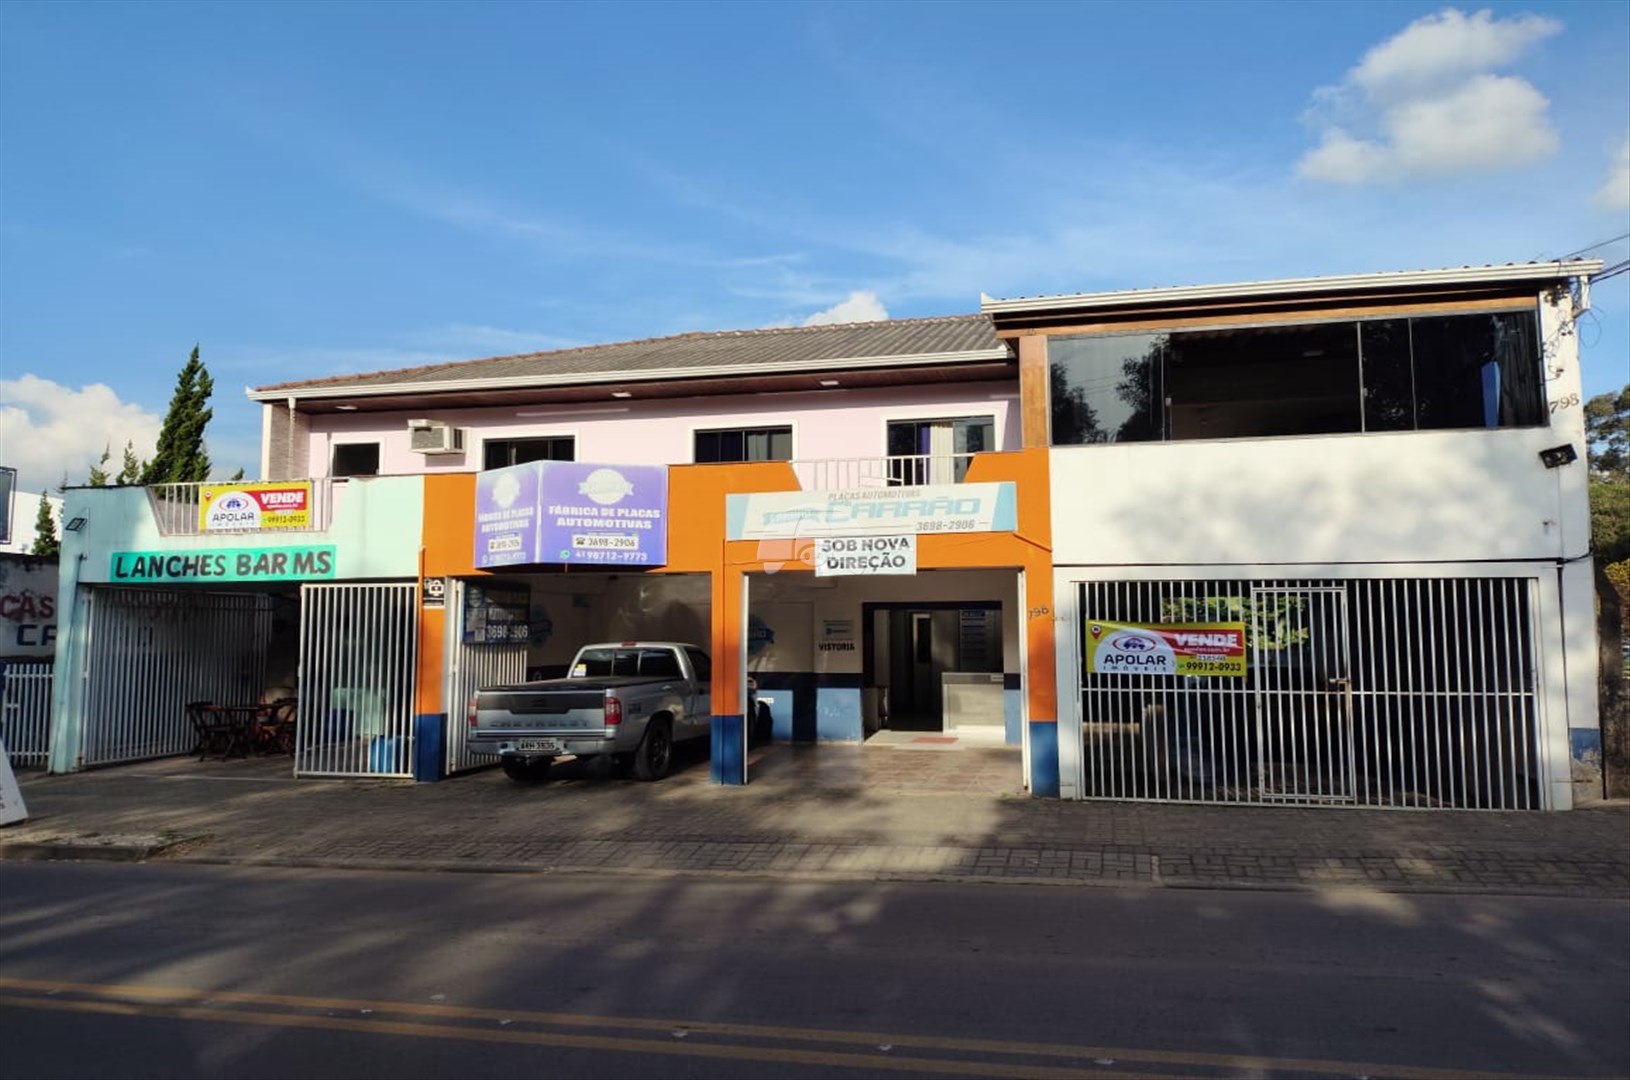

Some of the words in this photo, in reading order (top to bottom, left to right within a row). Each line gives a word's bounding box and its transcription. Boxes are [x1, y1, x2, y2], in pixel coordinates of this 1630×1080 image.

[1550, 393, 1579, 414] 798
[260, 491, 304, 504] VENDE
[212, 512, 255, 522] APOLAR
[549, 505, 599, 517] FÁBRICA
[601, 508, 616, 517] DE
[617, 508, 661, 519] PLACAS
[556, 517, 653, 529] AUTOMOTIVAS
[916, 520, 976, 531] 3698-2906
[821, 540, 857, 553] SOB
[861, 537, 910, 552] NOVA
[115, 554, 226, 578] LANCHES
[236, 552, 288, 577] BAR
[293, 550, 332, 575] MS
[826, 552, 906, 572] DIREÇÃO
[1173, 633, 1238, 647] VENDE
[1104, 654, 1166, 666] APOLAR
[1186, 662, 1241, 671] 99912-0933
